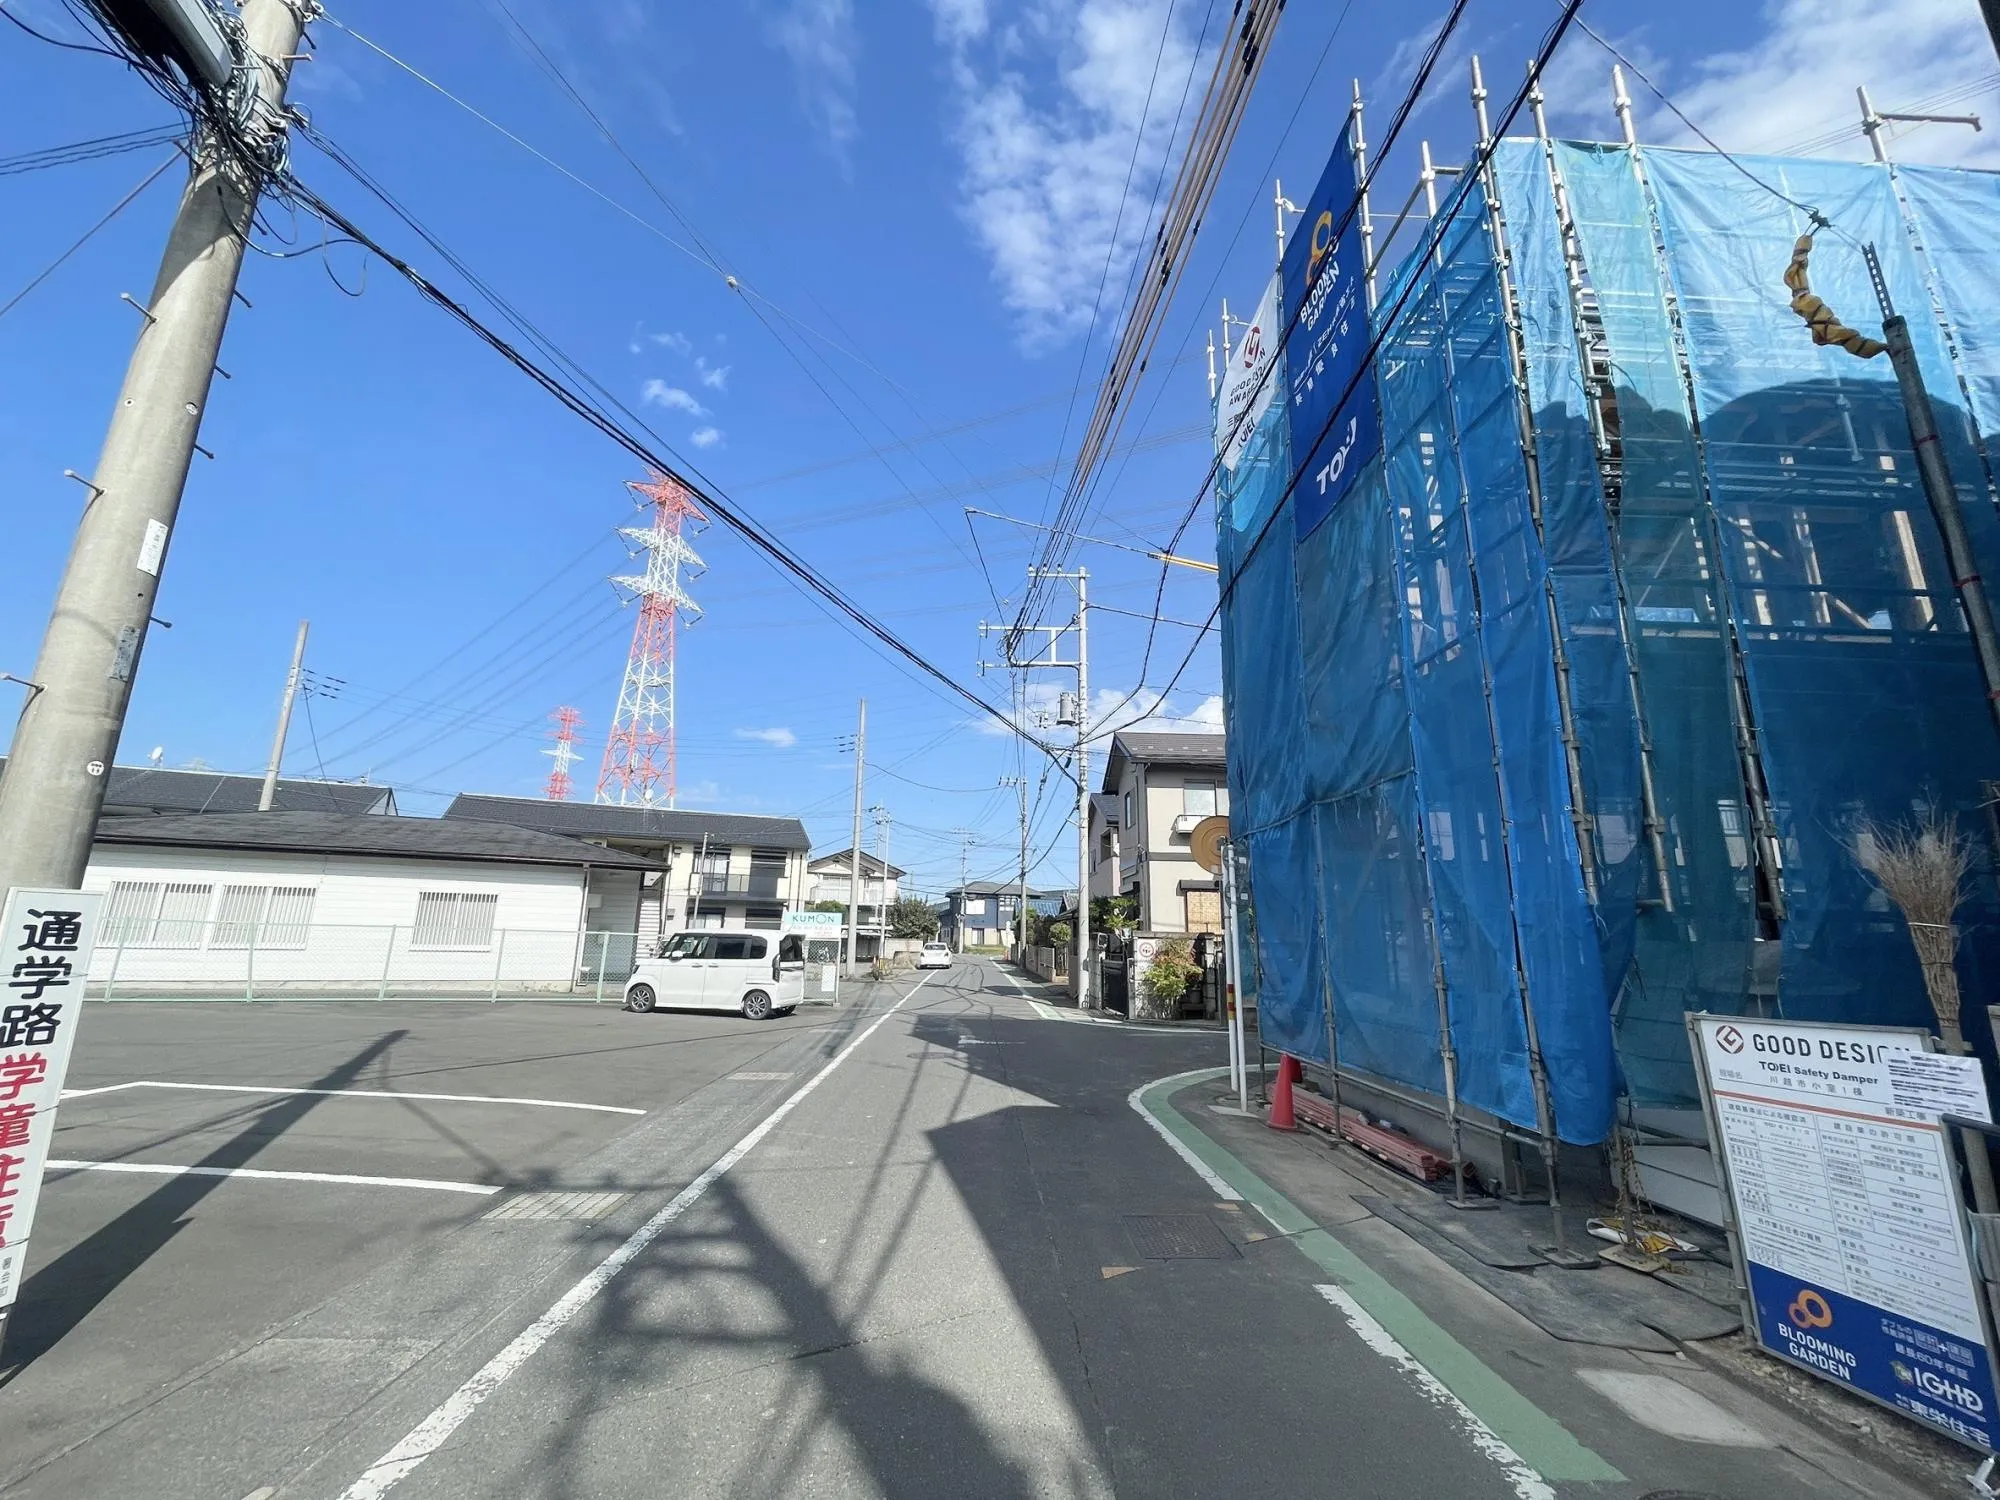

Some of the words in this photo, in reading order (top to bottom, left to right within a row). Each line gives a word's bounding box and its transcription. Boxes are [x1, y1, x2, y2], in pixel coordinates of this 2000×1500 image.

[792, 913, 835, 924] KUMON
[1753, 1033, 1811, 1057] GOOD
[1819, 1039, 1910, 1065] DESI
[1794, 1066, 1829, 1080] Safety
[1833, 1071, 1878, 1085] Damper
[1777, 1322, 1857, 1367] BLOOMING
[1789, 1342, 1851, 1381] GARDEN
